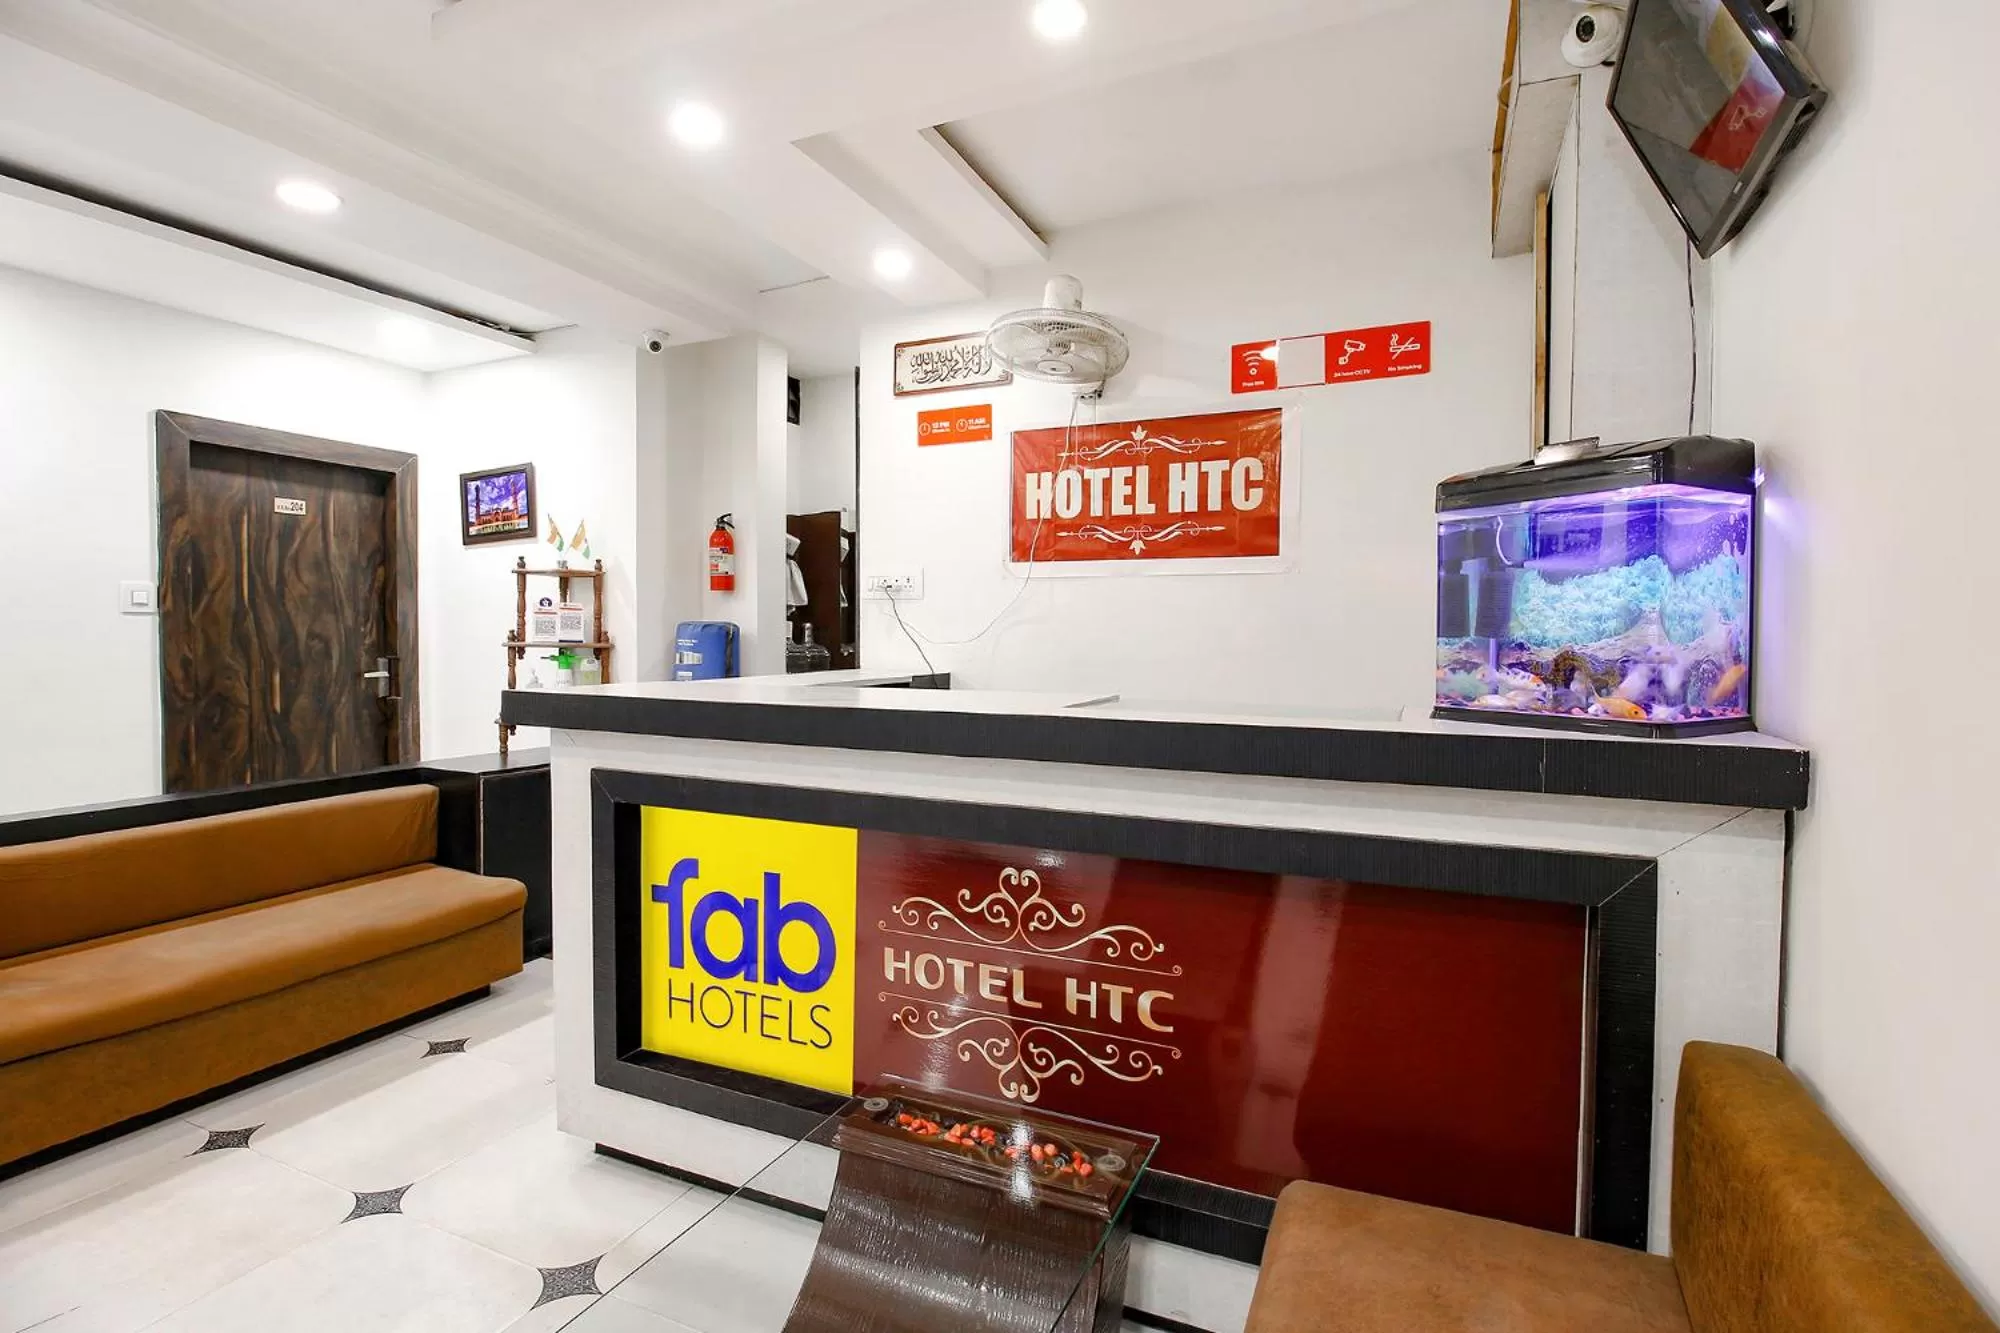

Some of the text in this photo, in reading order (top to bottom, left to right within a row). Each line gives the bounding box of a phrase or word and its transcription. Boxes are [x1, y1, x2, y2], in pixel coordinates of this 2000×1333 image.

[1026, 456, 1264, 520] HOTEL HTC
[651, 857, 837, 994] fab
[667, 977, 833, 1050] HOTELS
[883, 947, 1175, 1034] HOTEL HTC
